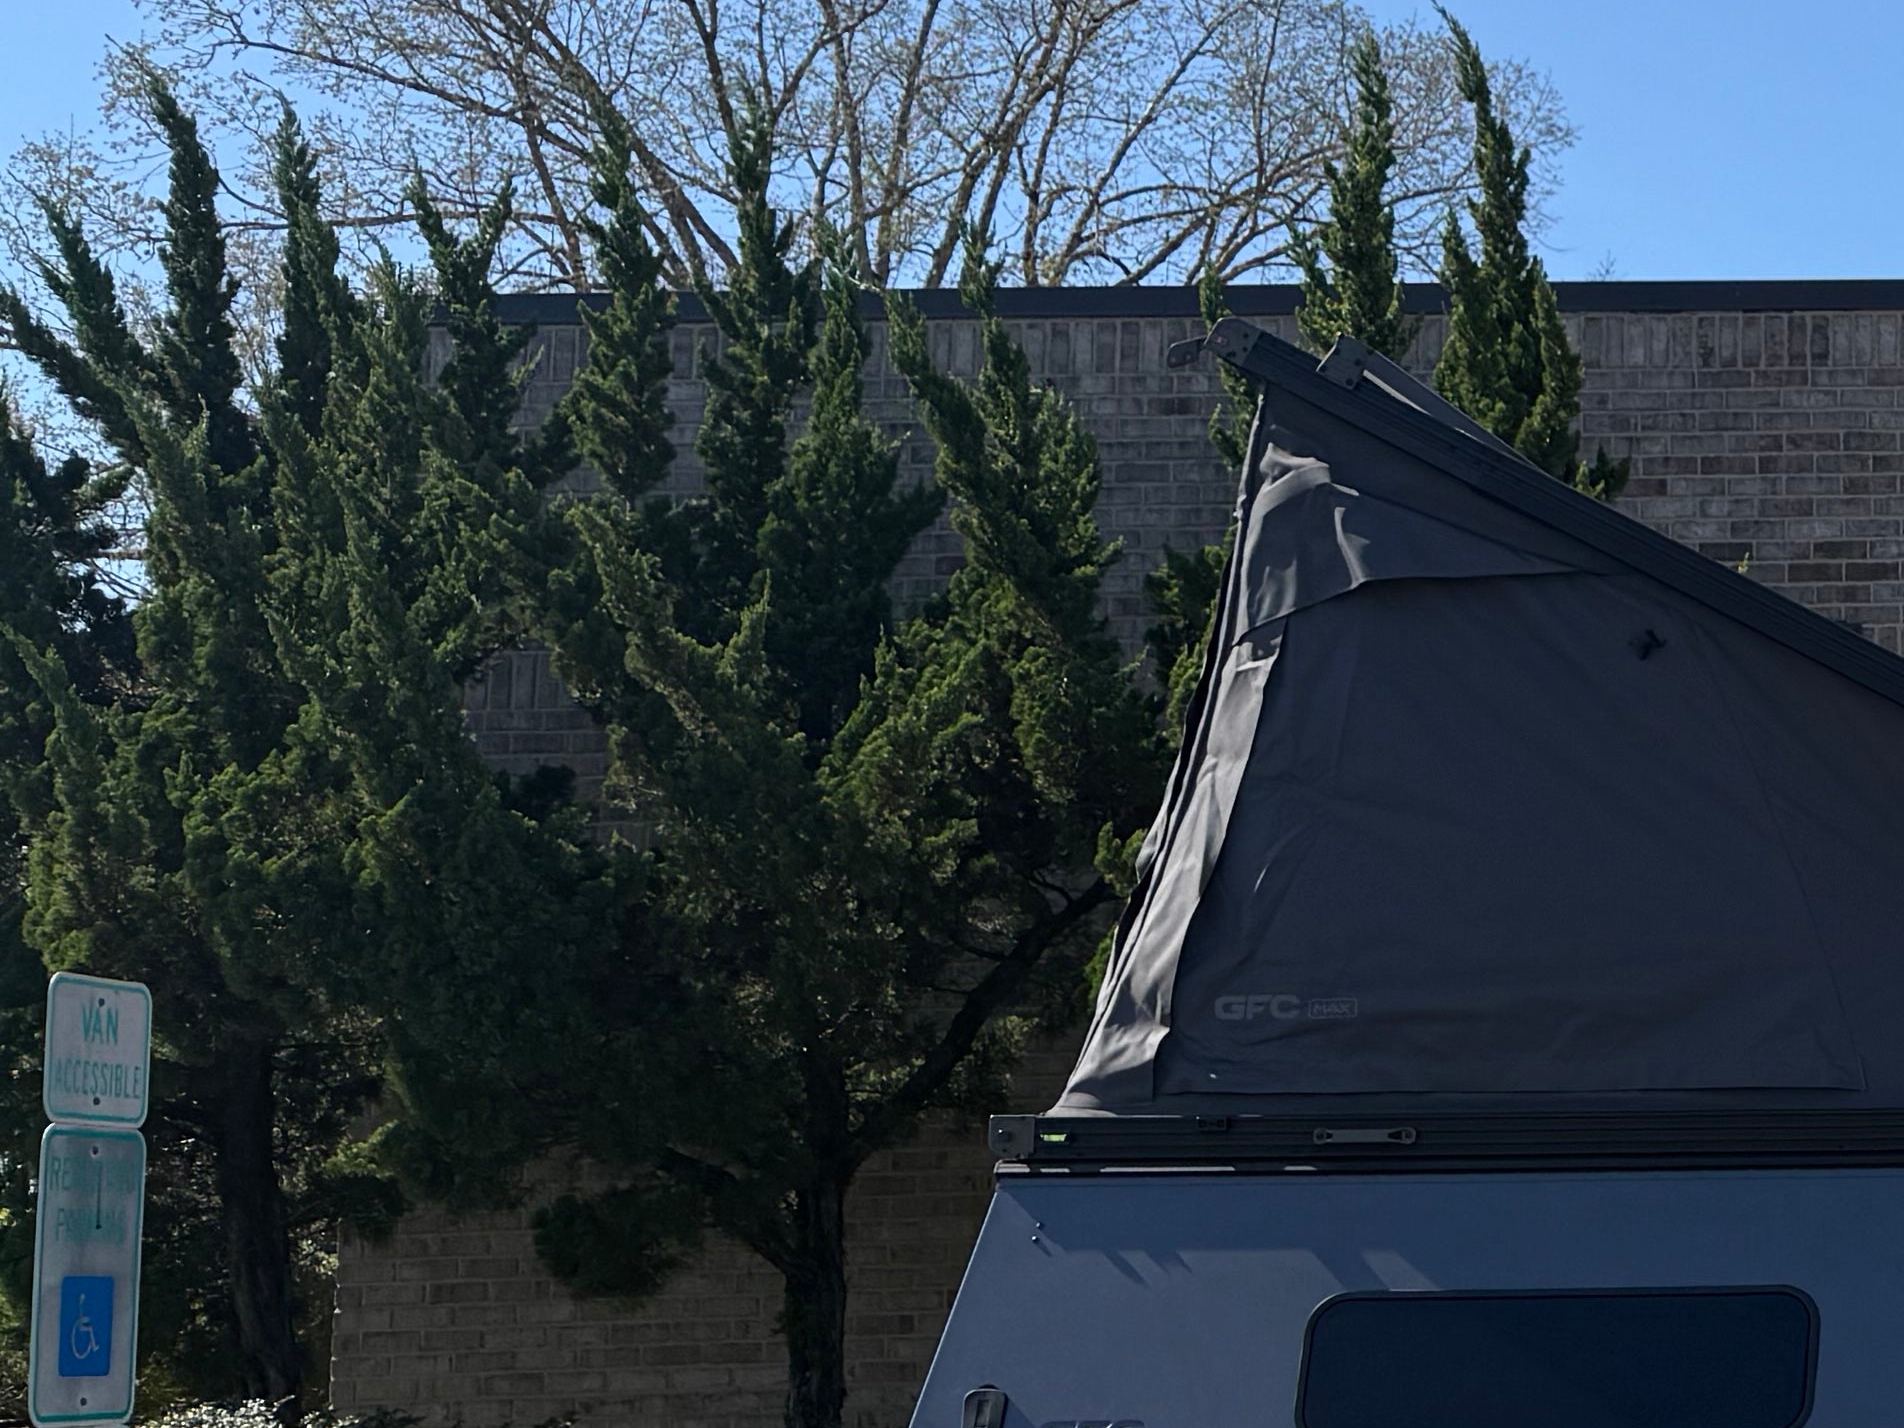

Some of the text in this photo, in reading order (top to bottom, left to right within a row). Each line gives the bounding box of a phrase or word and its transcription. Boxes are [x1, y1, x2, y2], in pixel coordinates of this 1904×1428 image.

[81, 1006, 119, 1046] VAN
[1214, 993, 1301, 1021] GFC
[53, 1057, 142, 1100] ACCESSIBLE
